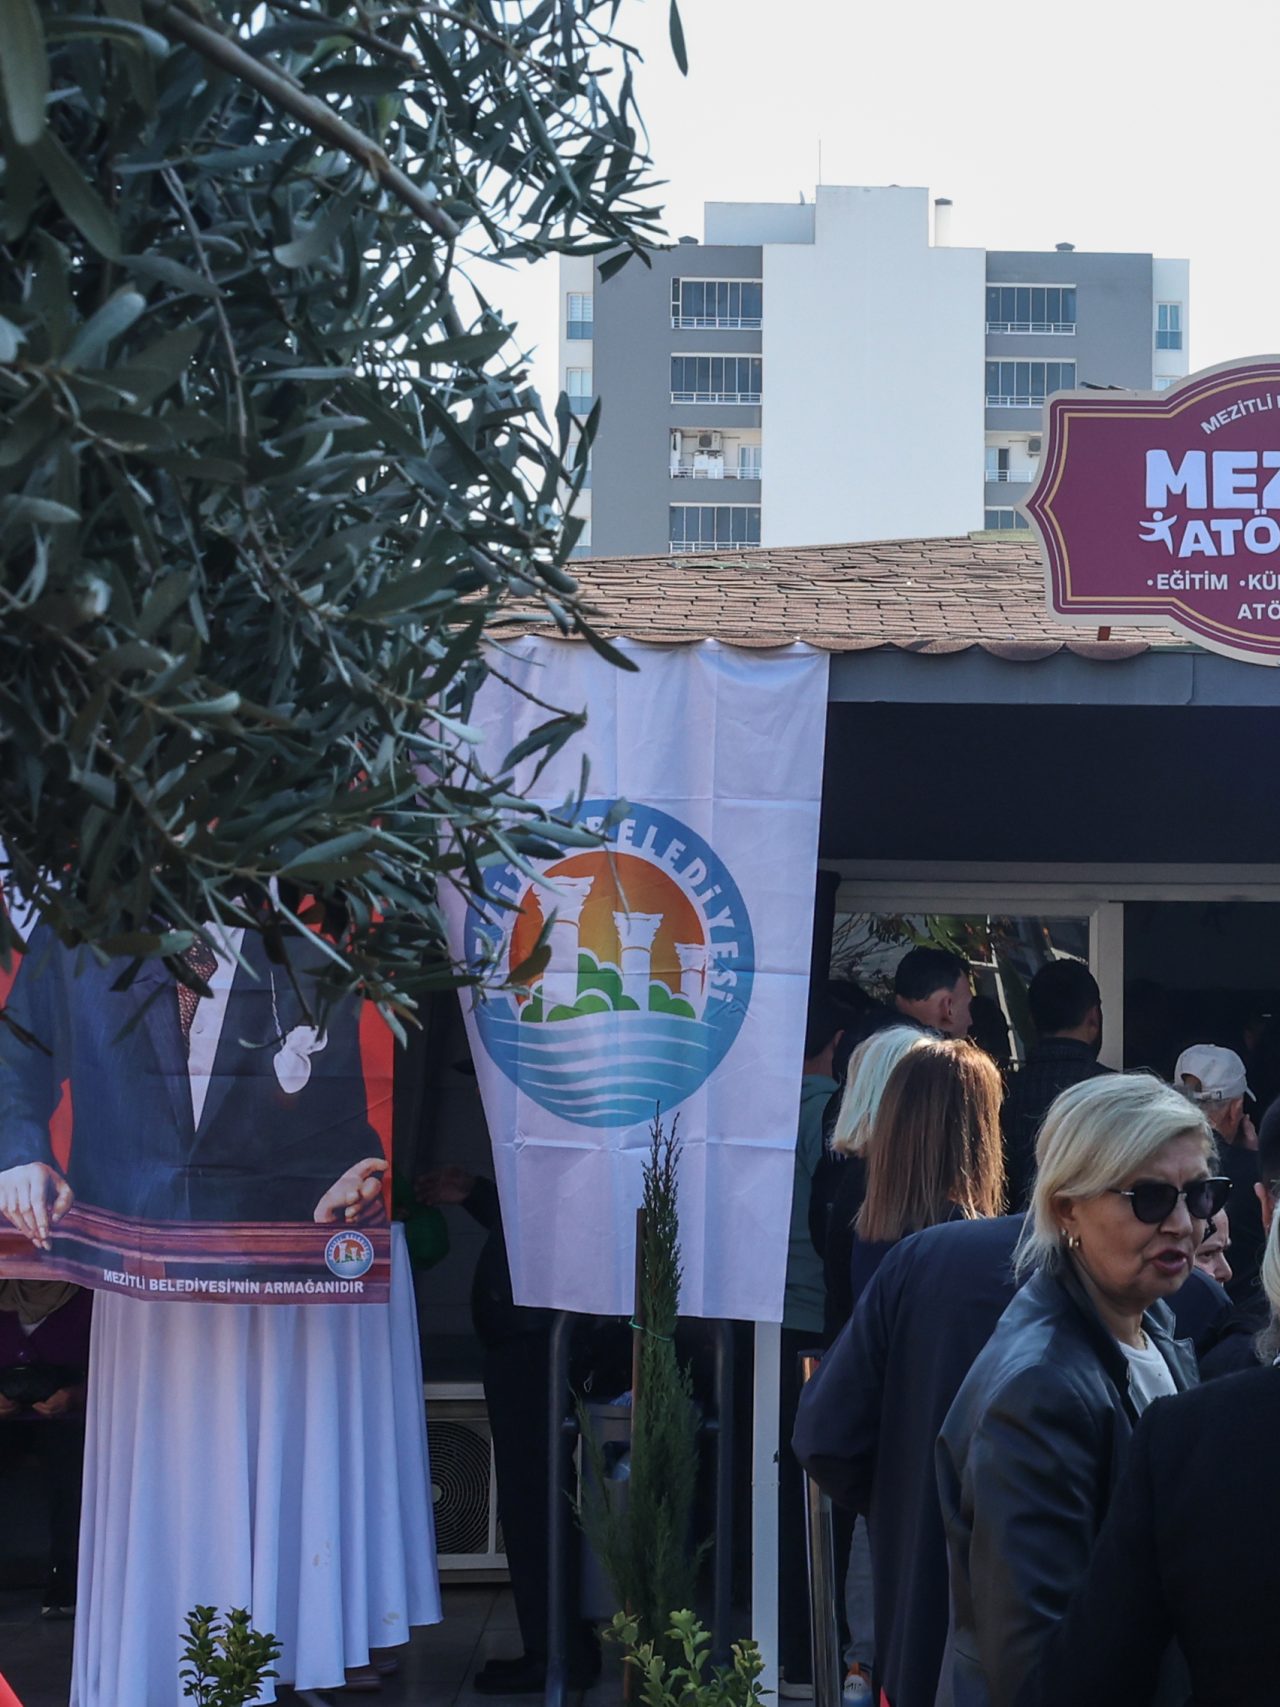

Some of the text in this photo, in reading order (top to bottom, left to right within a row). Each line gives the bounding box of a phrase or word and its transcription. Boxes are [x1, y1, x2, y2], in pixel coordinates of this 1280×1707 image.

[1200, 393, 1272, 434] MEZİTLİ
[103, 1269, 146, 1290] MEZİTLİ
[264, 1279, 364, 1294] ARMAĞANIDIR
